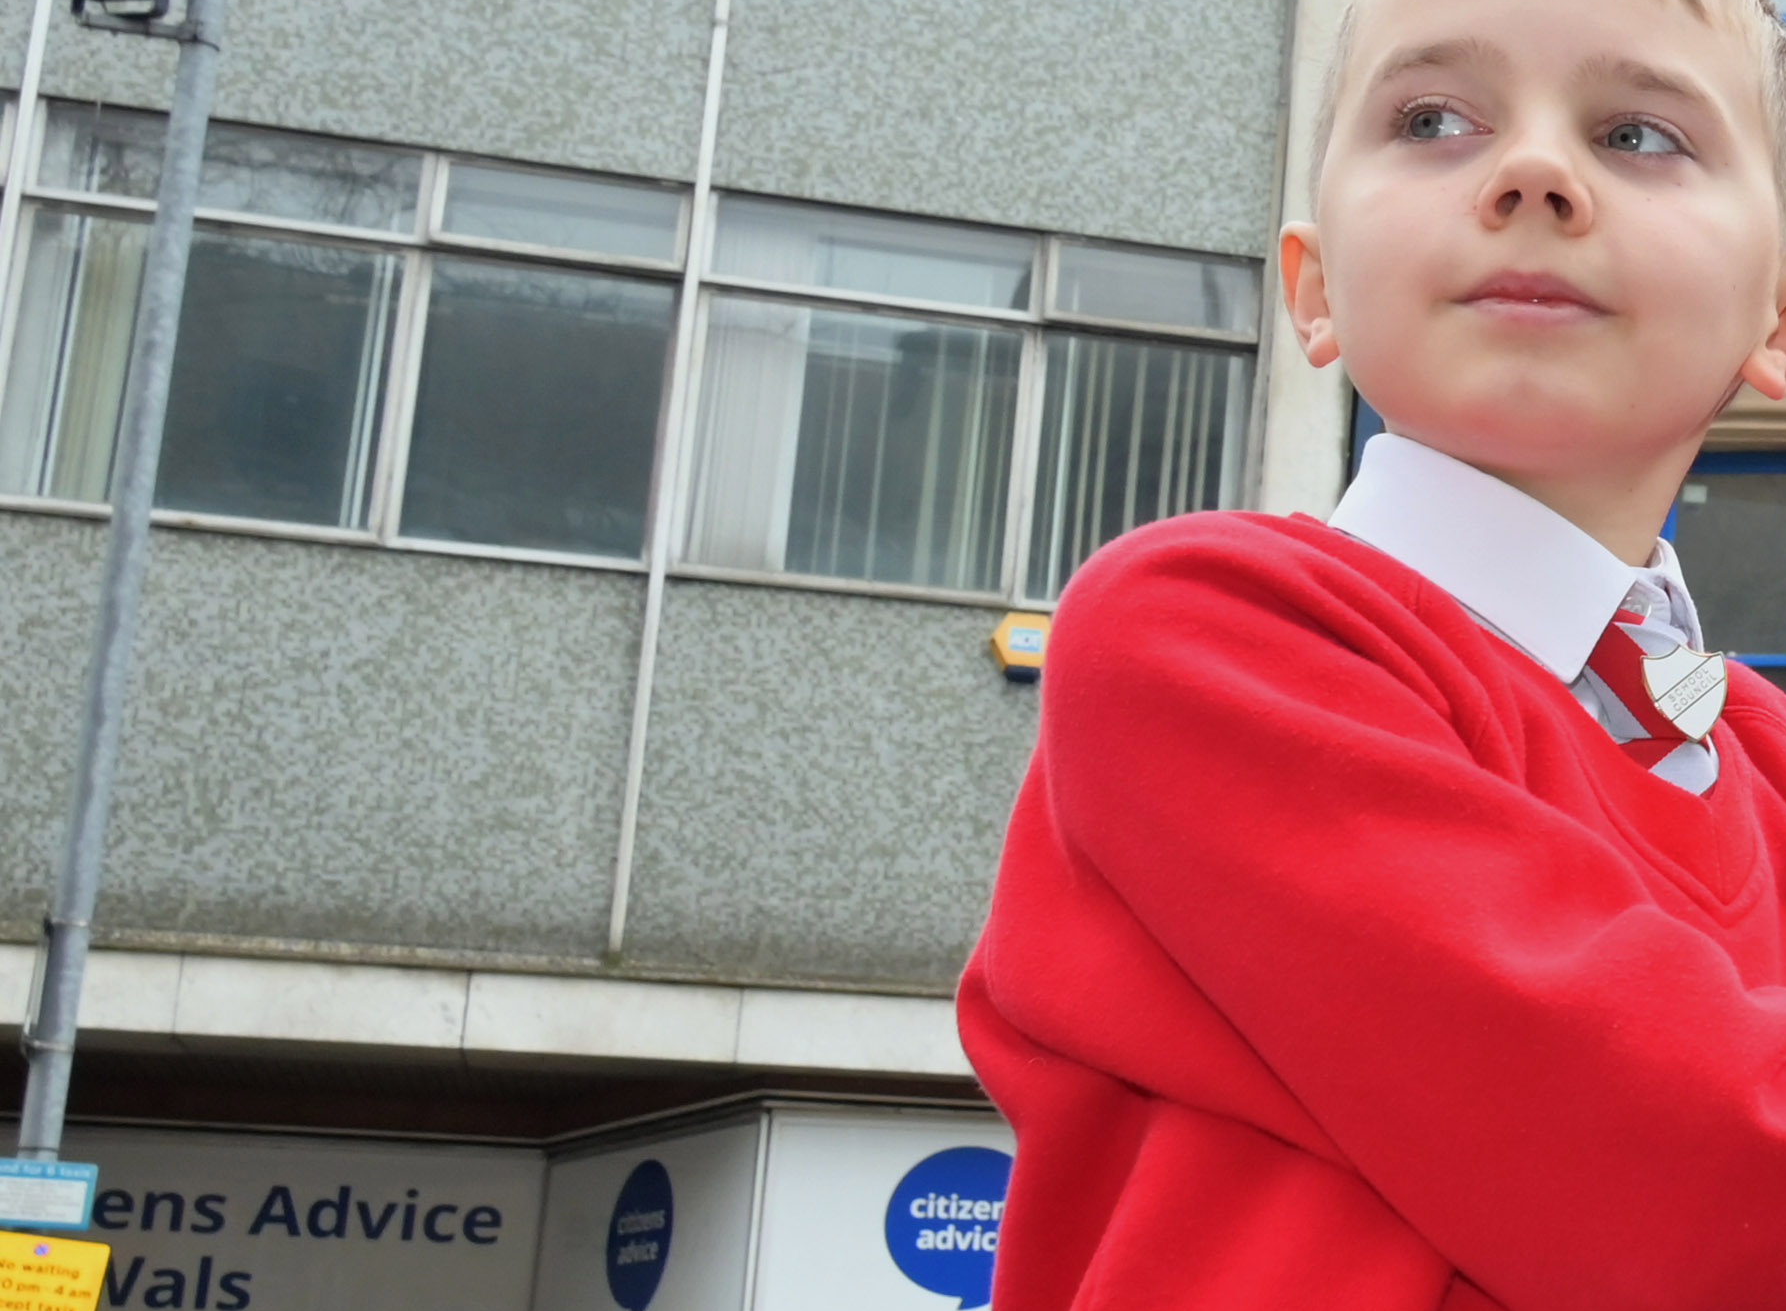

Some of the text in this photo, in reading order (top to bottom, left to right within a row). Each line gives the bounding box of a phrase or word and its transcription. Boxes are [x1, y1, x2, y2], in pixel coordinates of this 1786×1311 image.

[1668, 668, 1709, 702] SCHOOL
[1673, 673, 1717, 712] COUNCIL
[248, 1184, 502, 1245] Advice
[617, 1209, 666, 1235] citizens
[617, 1240, 659, 1265] advice
[22, 1264, 80, 1280] waiting
[69, 1290, 92, 1299] am
